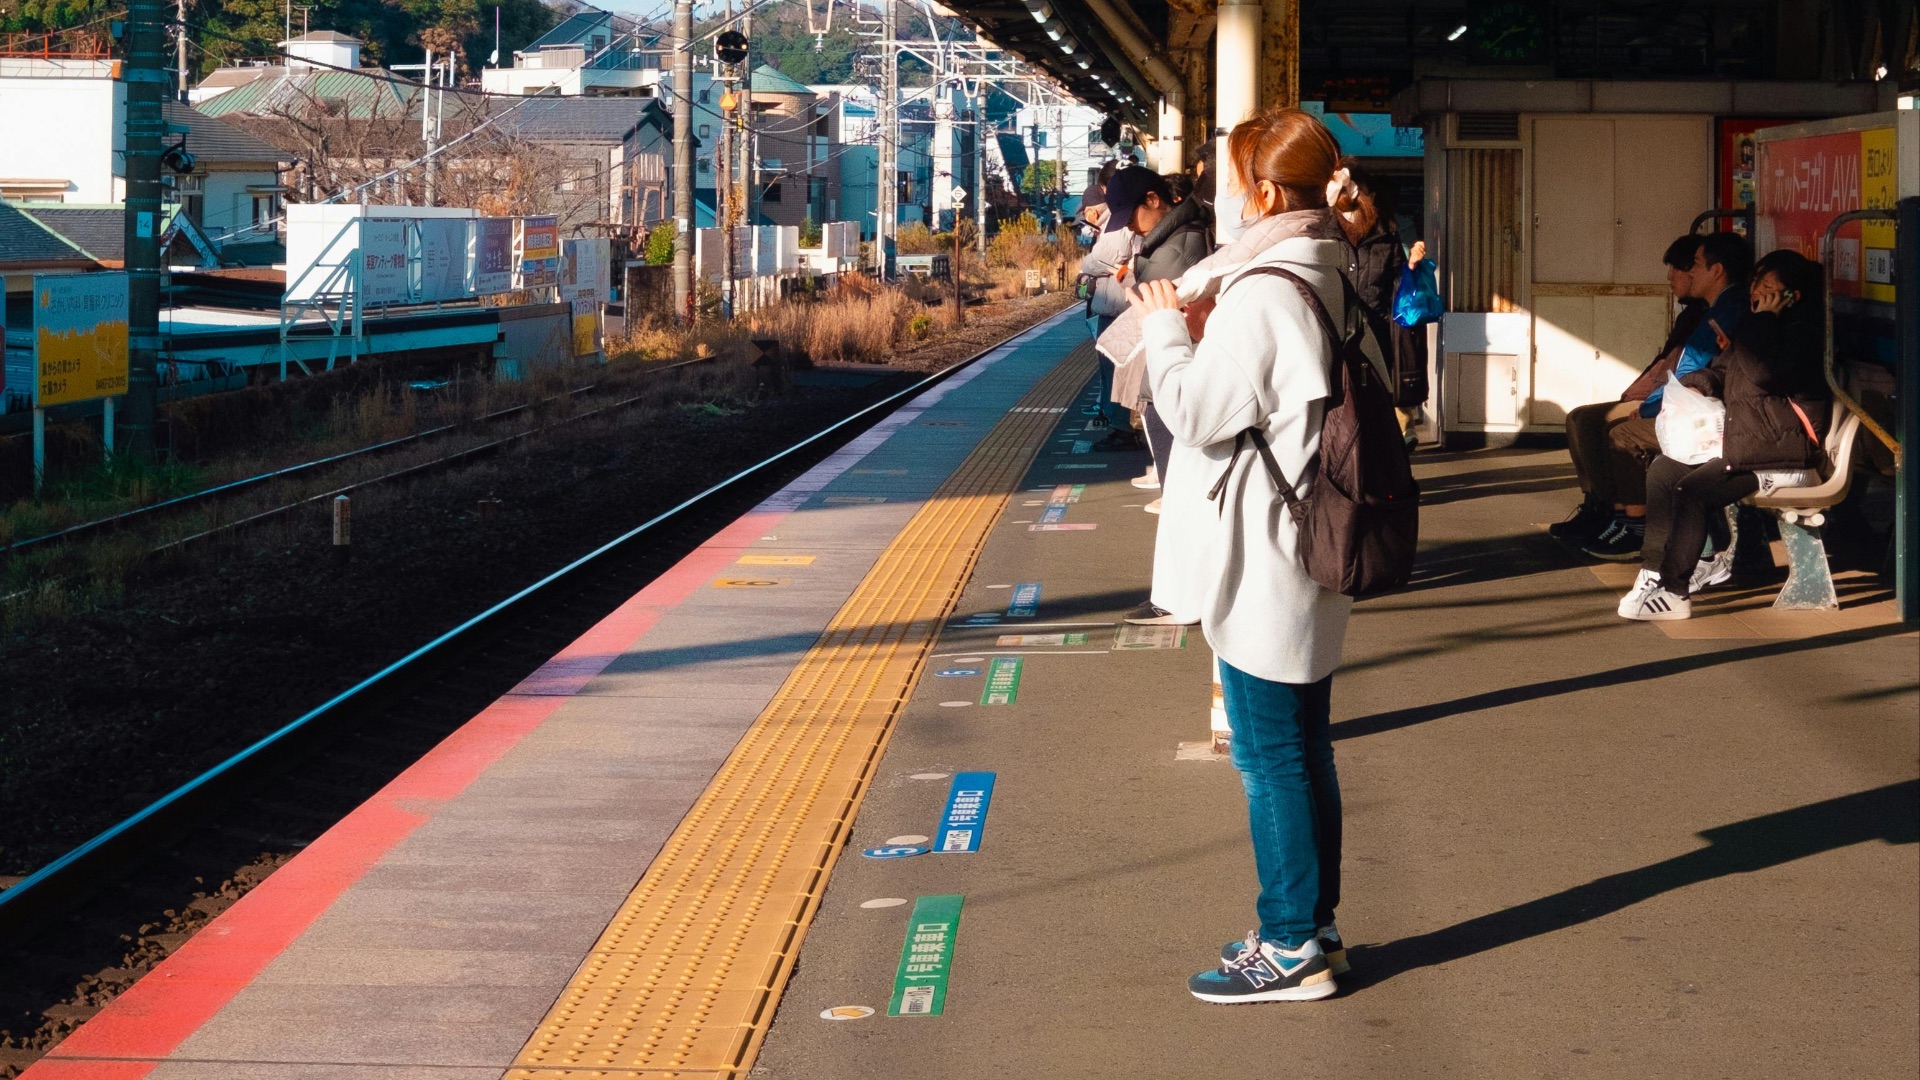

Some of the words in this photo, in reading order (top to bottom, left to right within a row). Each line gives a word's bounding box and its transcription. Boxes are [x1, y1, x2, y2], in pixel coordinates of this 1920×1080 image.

[1867, 148, 1893, 178] 西口より
[1773, 152, 1861, 212] ホットヨガLAVA
[1027, 271, 1039, 281] 85
[42, 358, 81, 377] 鼻からの胃カメラ
[947, 790, 985, 827] 1号車乗車口
[873, 847, 918, 856] 5
[904, 922, 950, 981] 1号車乗車口
[1241, 959, 1279, 989] N
